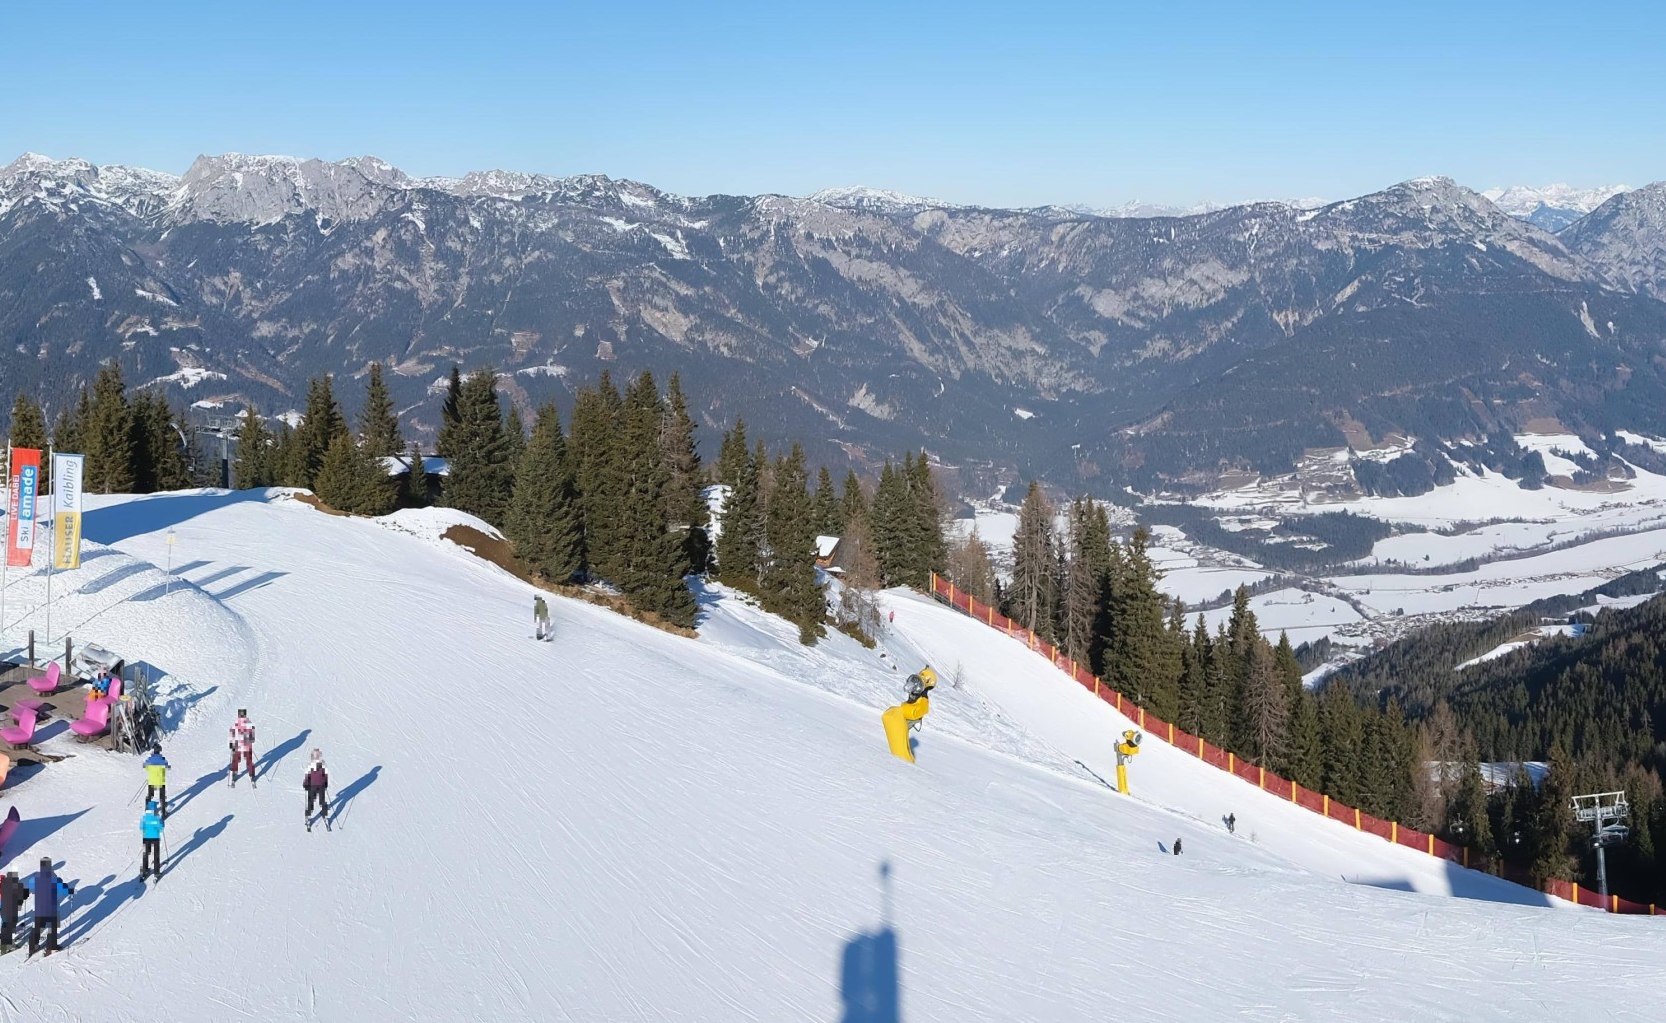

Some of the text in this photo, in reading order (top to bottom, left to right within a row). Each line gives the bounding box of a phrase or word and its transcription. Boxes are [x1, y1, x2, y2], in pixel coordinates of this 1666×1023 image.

[20, 468, 34, 542] Ski amade
[63, 459, 77, 565] HAUSER Kaibling
